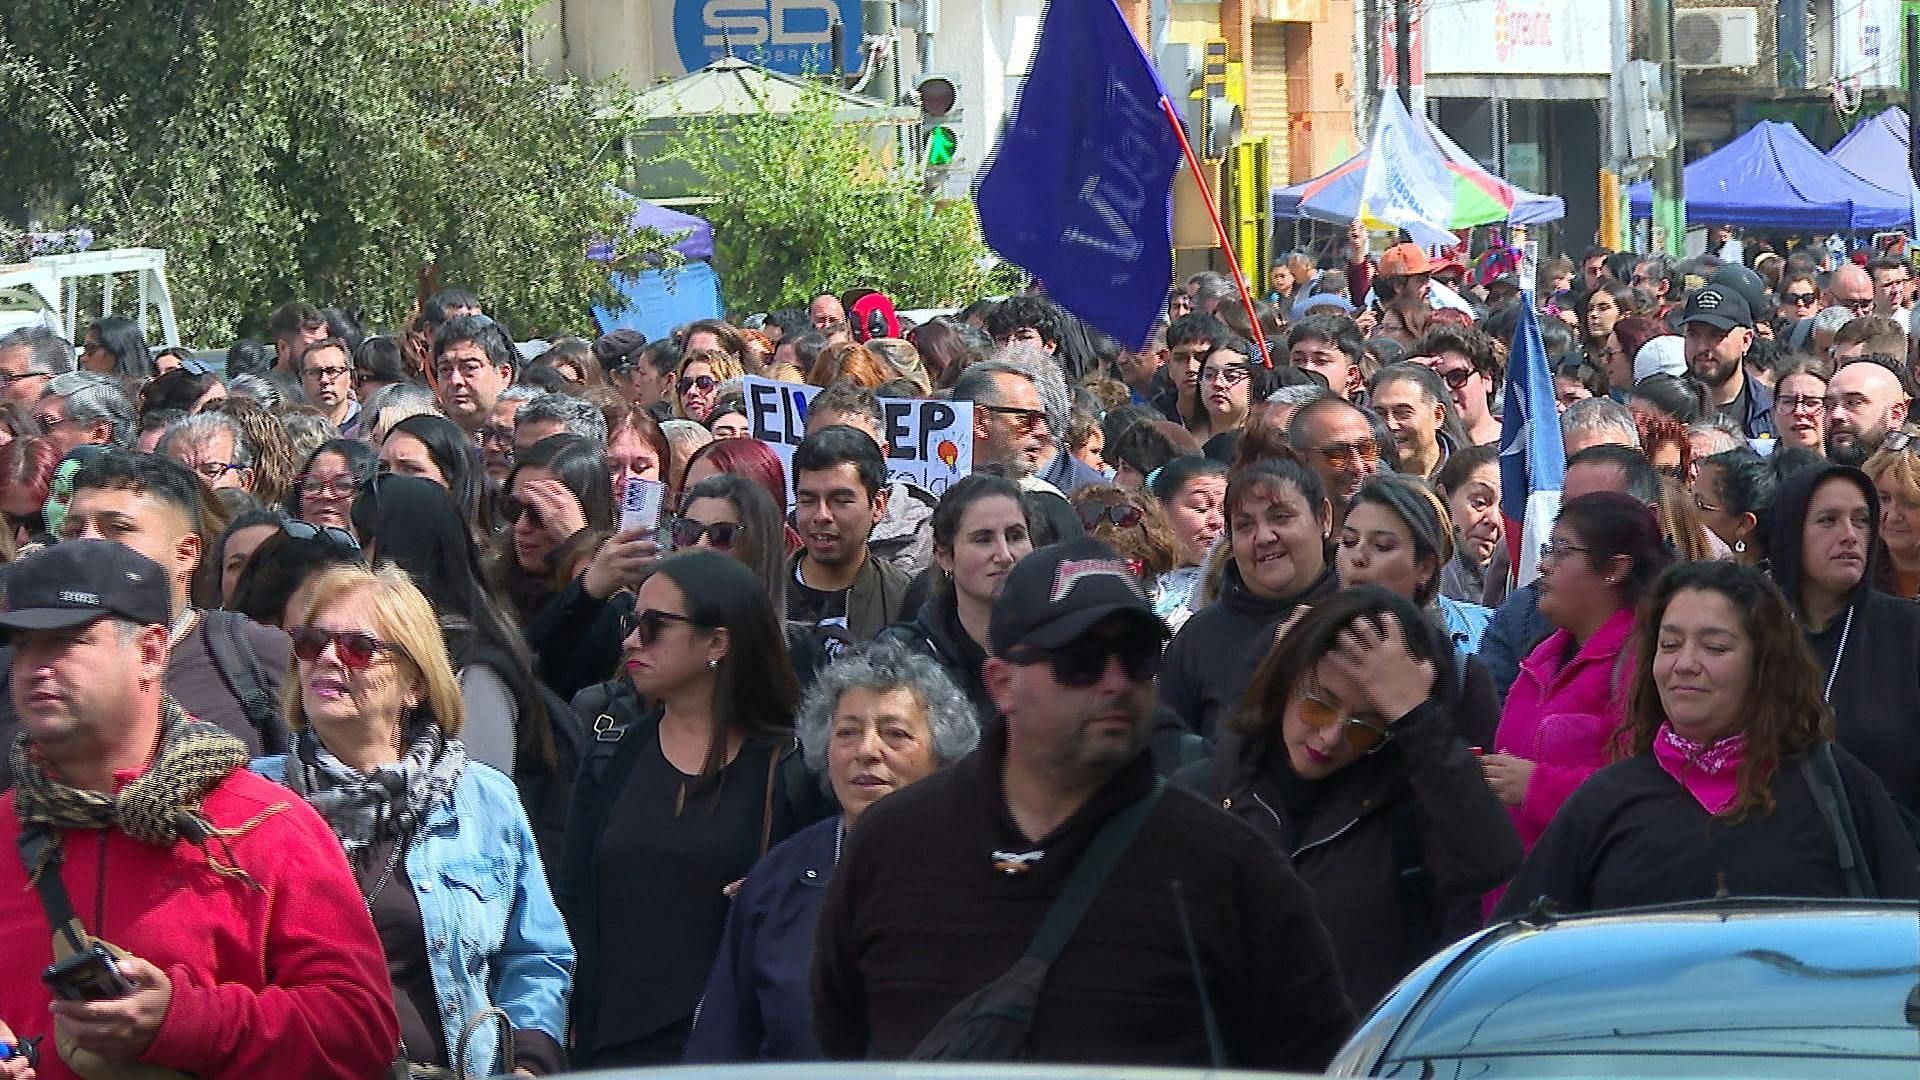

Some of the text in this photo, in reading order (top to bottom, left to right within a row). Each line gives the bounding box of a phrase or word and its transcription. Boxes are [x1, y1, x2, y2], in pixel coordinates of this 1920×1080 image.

[703, 0, 841, 46] SD
[750, 383, 956, 462] EL EP
[59, 590, 100, 605] SPORTS
